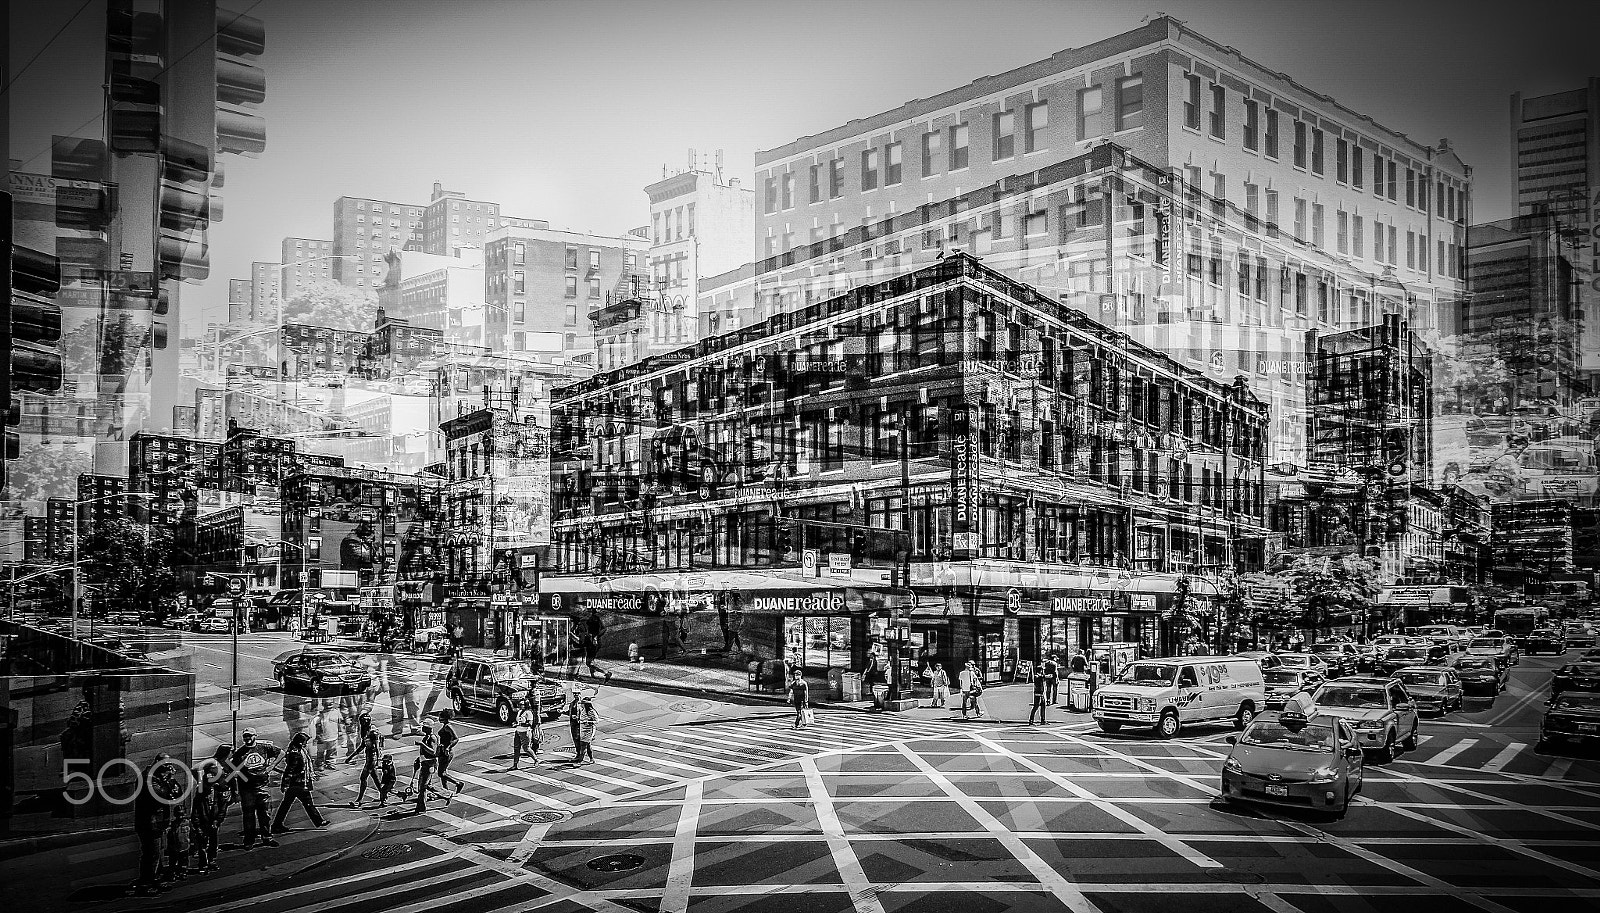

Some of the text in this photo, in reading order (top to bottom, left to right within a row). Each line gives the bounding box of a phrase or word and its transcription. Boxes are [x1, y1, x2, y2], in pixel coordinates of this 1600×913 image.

[953, 433, 967, 521] DUANEreade
[586, 594, 642, 609] DUANEreade
[754, 591, 842, 610] DUANEreade
